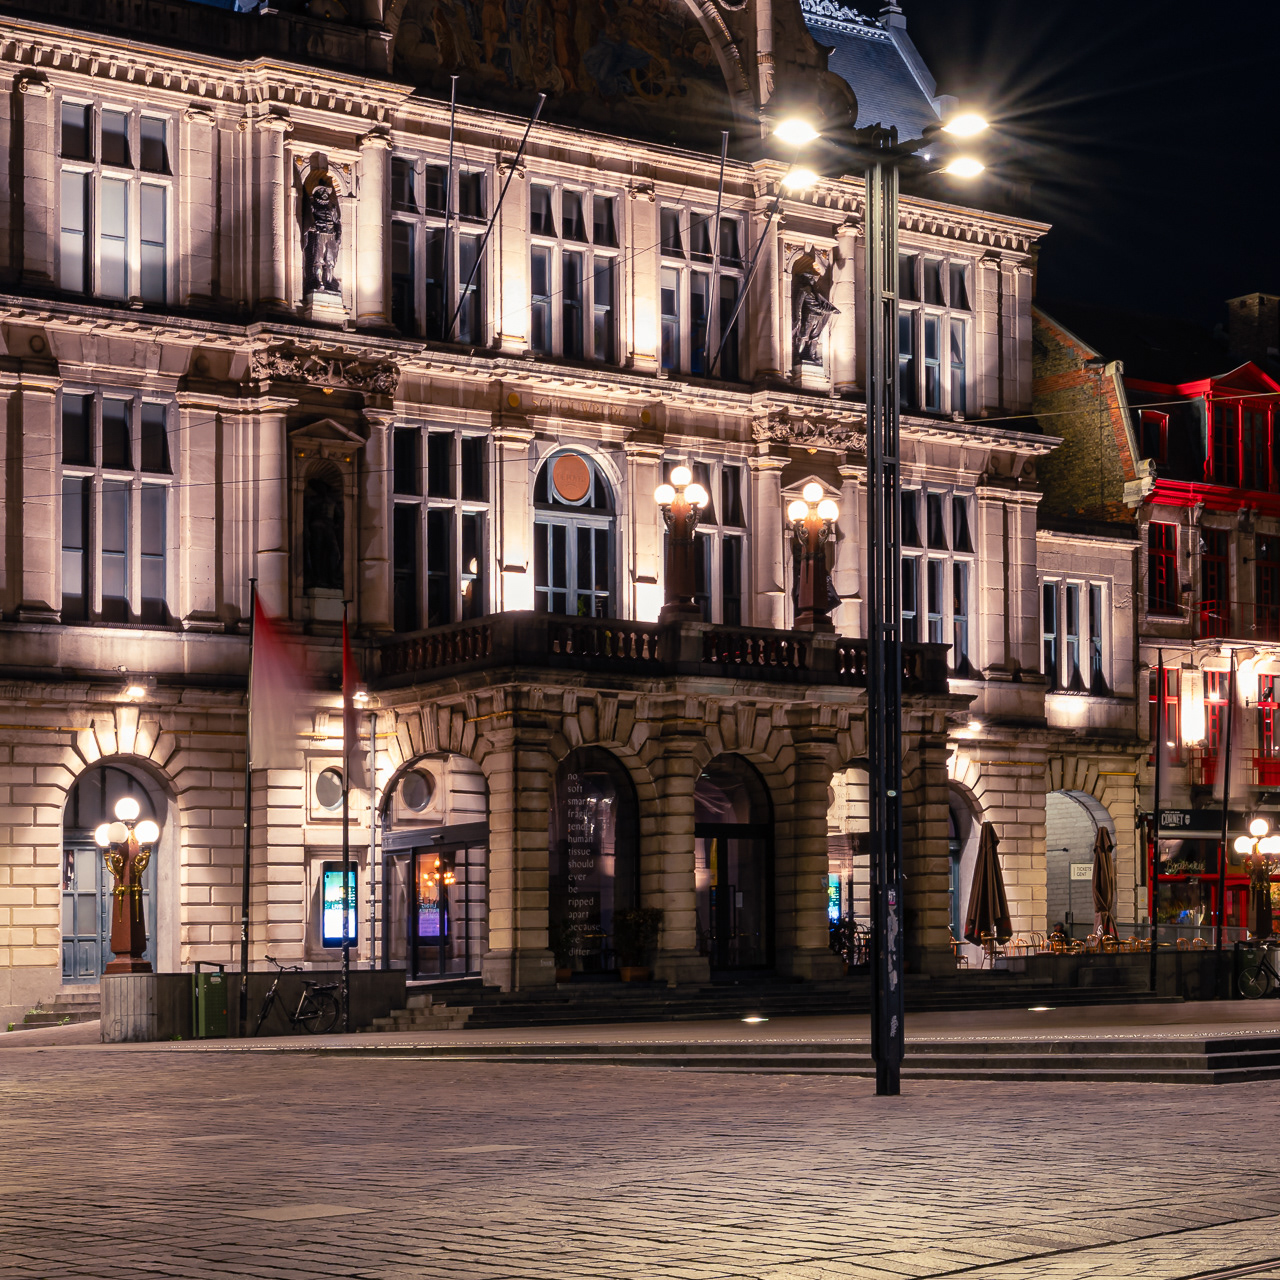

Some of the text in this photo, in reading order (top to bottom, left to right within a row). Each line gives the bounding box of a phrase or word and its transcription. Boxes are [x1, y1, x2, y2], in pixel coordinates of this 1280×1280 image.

[567, 785, 583, 793] soft
[567, 808, 593, 820] fragile
[1161, 813, 1184, 824] CORNET
[567, 834, 593, 843] human
[568, 848, 591, 856] tissue
[568, 859, 594, 868] should
[568, 885, 579, 894] be
[568, 897, 594, 908] ripped
[568, 911, 589, 920] apart
